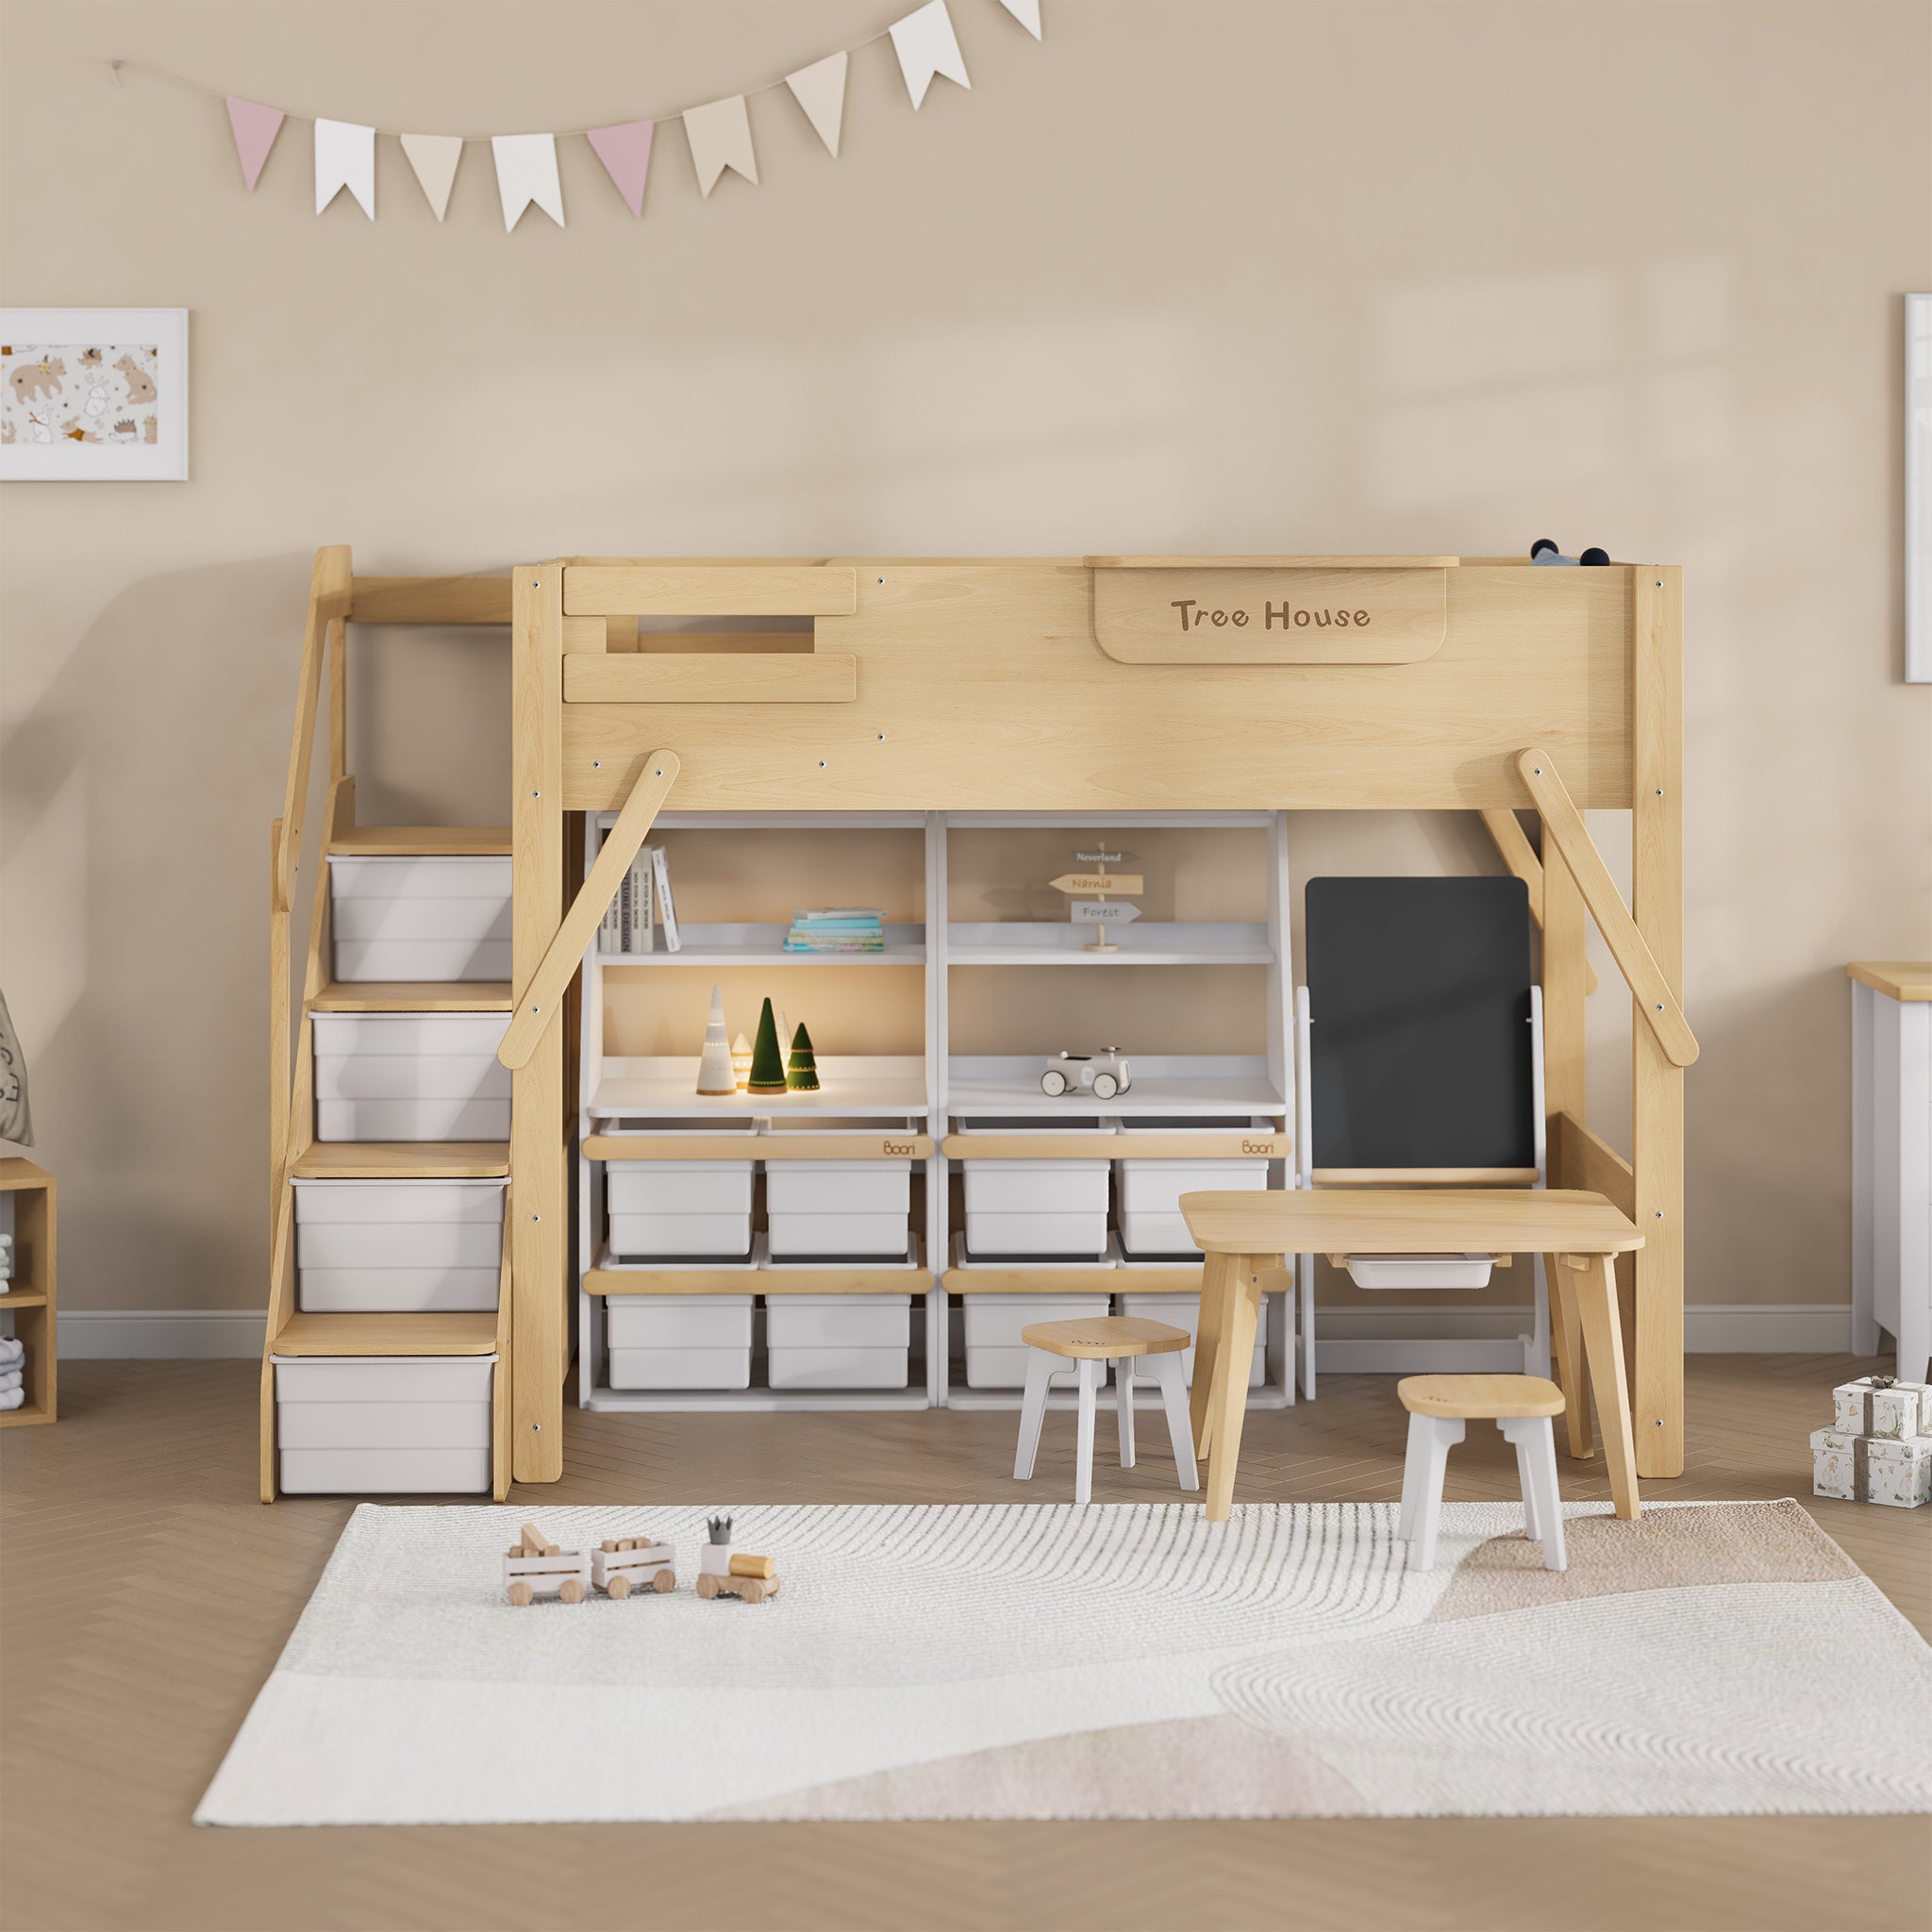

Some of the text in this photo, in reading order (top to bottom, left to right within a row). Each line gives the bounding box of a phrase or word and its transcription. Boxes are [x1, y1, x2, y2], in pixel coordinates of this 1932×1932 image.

[1171, 599, 1371, 631] Tree House
[1076, 853, 1122, 862] Neverland
[1072, 877, 1112, 889] Narnia
[1083, 908, 1121, 918] Forest
